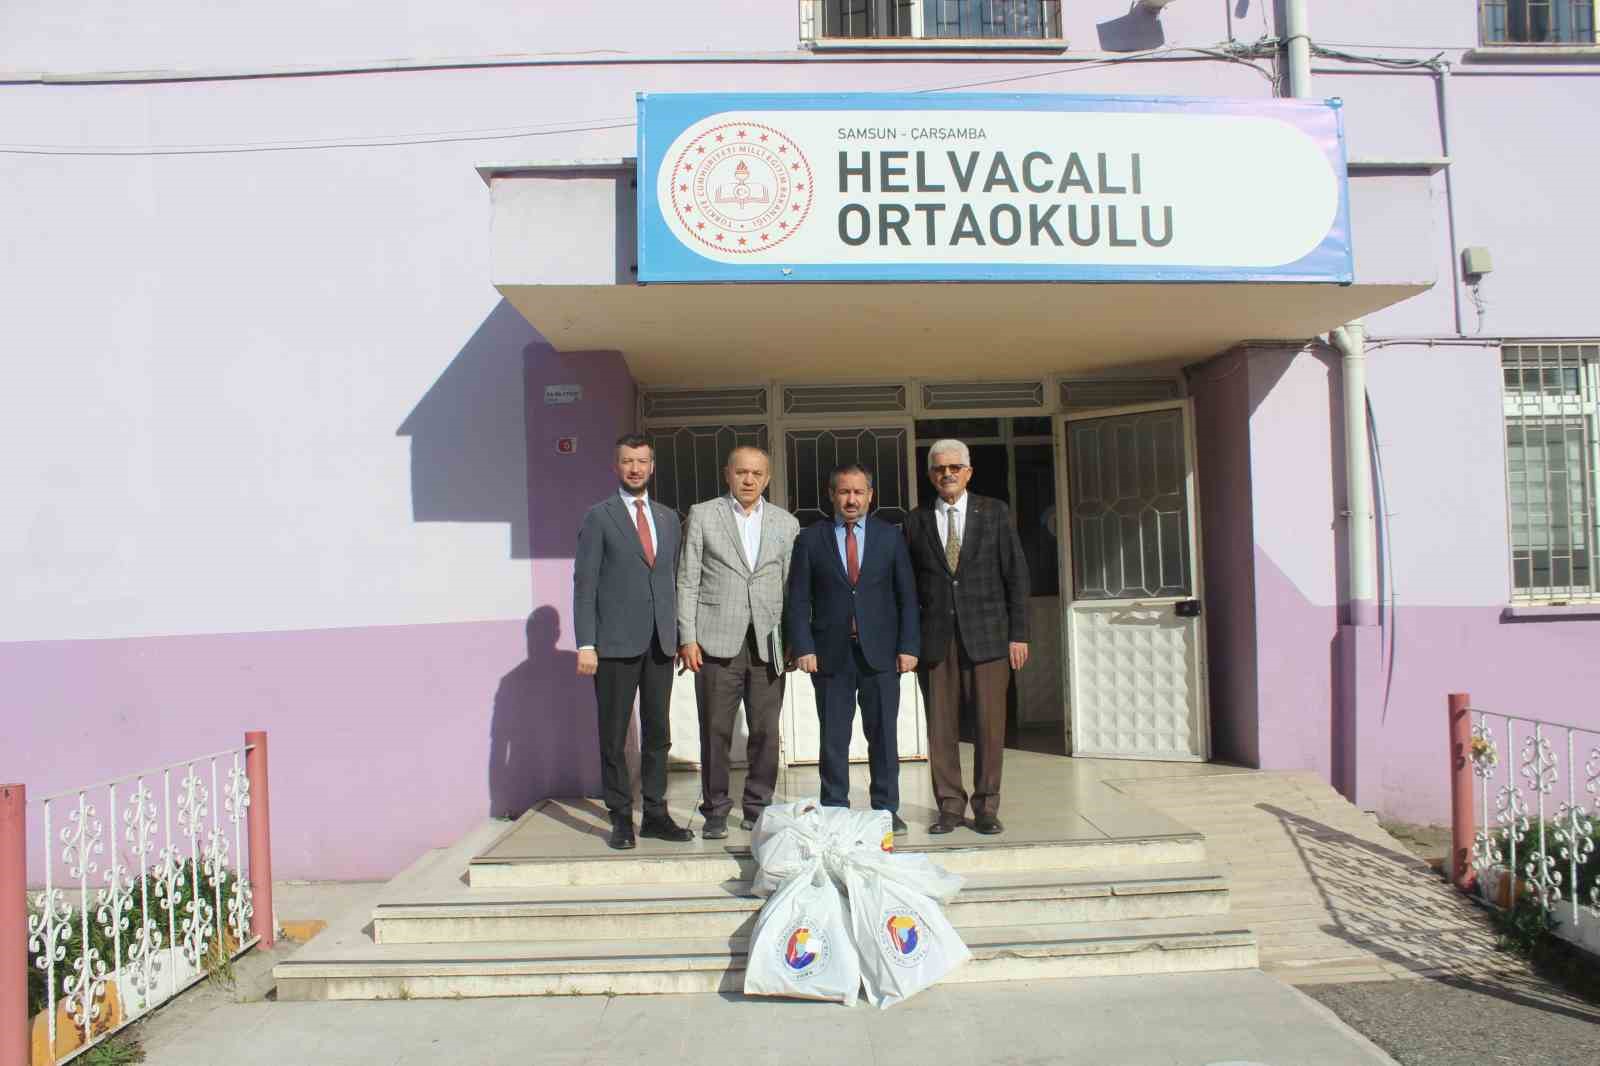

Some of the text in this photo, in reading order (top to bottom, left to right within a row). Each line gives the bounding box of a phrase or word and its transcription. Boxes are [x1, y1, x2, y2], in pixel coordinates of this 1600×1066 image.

[838, 127, 897, 140] SAMSUN
[911, 127, 987, 142] ÇARŞAMBA
[838, 150, 1141, 195] HELVACALI
[838, 203, 1173, 248] ORTAOKULU
